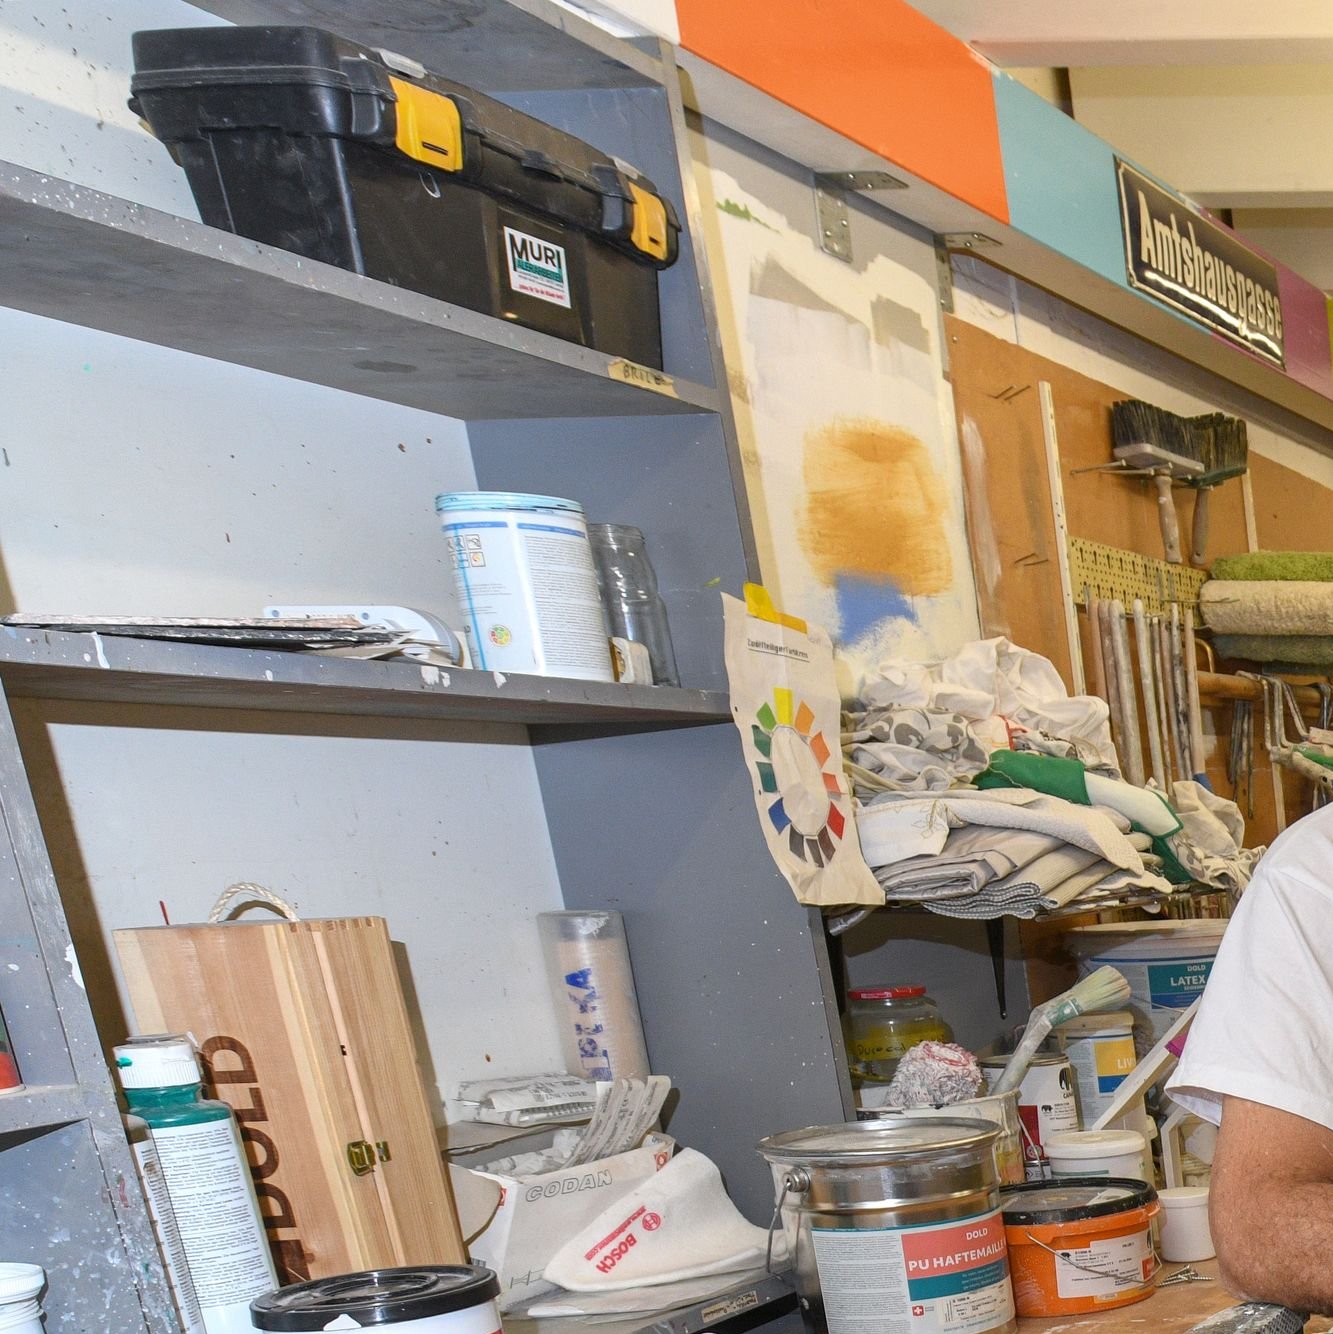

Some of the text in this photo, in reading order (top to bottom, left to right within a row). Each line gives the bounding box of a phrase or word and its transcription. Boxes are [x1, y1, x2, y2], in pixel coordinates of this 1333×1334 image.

[508, 232, 563, 271] MURI
[1138, 190, 1283, 340] Amtshausgasse
[525, 1168, 614, 1203] CODAN
[965, 1227, 988, 1241] DOLD
[595, 1232, 638, 1274] BOSCH
[908, 1239, 1004, 1272] PU HAFTEMAILLE
